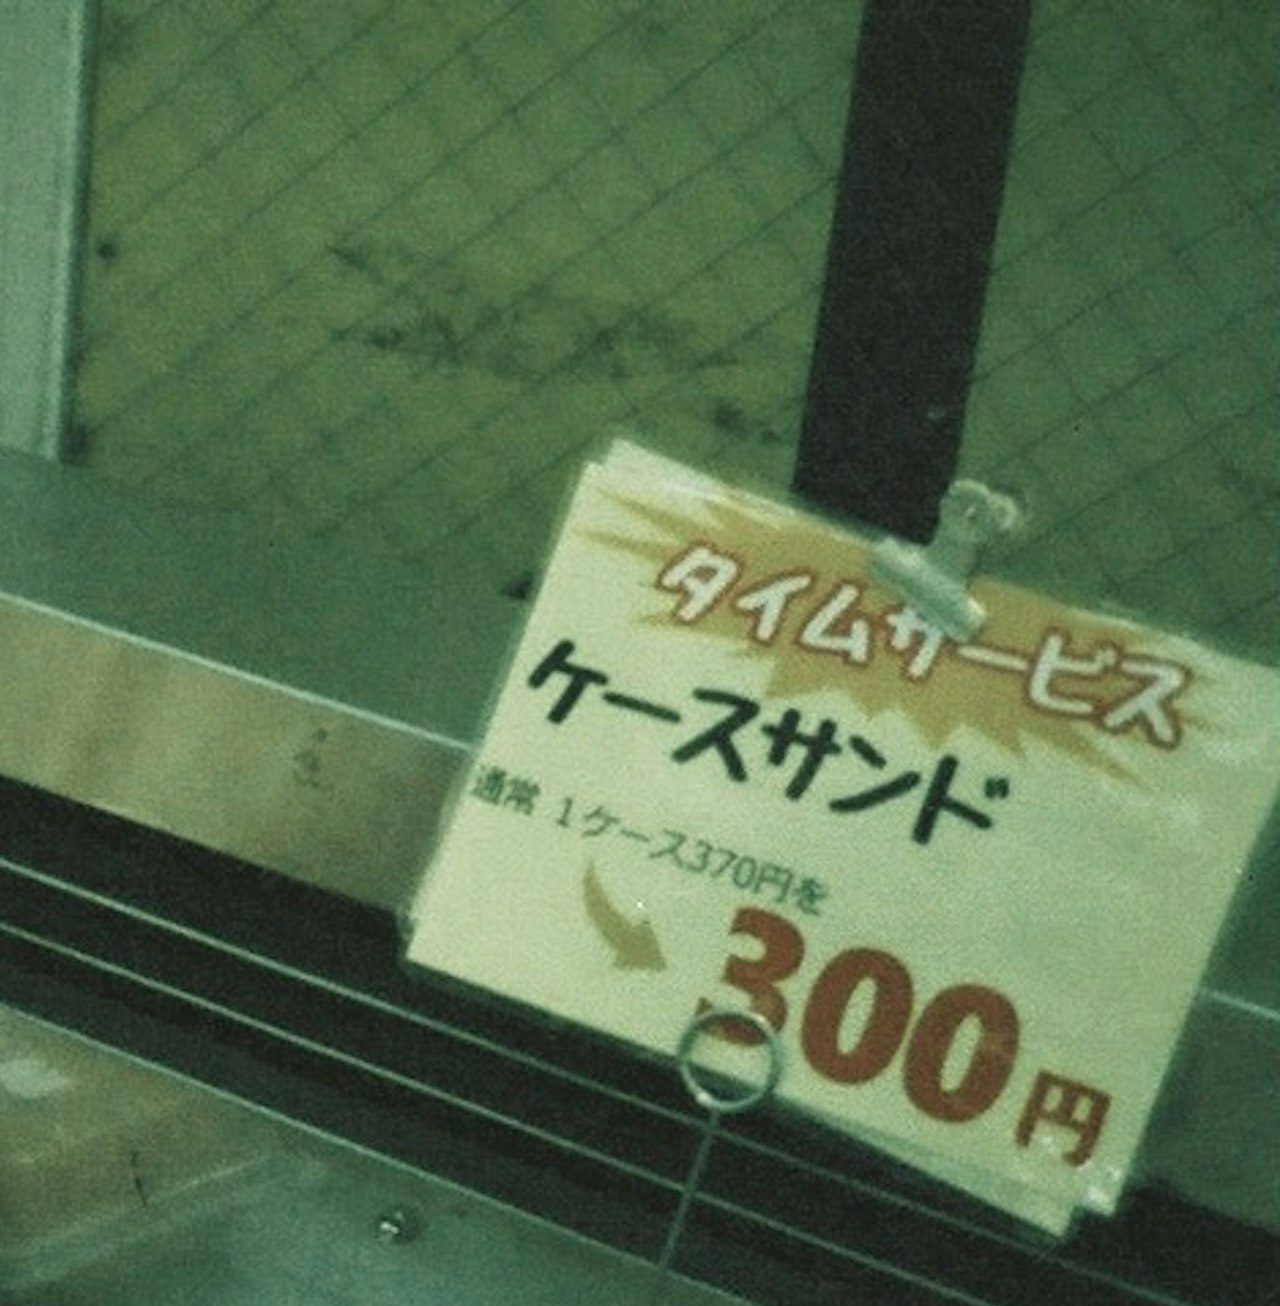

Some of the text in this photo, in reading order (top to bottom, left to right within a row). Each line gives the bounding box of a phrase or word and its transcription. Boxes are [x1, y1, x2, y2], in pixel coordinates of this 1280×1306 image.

[526, 638, 1011, 846] ケースサンド
[656, 540, 1192, 747] タイムサービス
[696, 907, 1113, 1168] 300円
